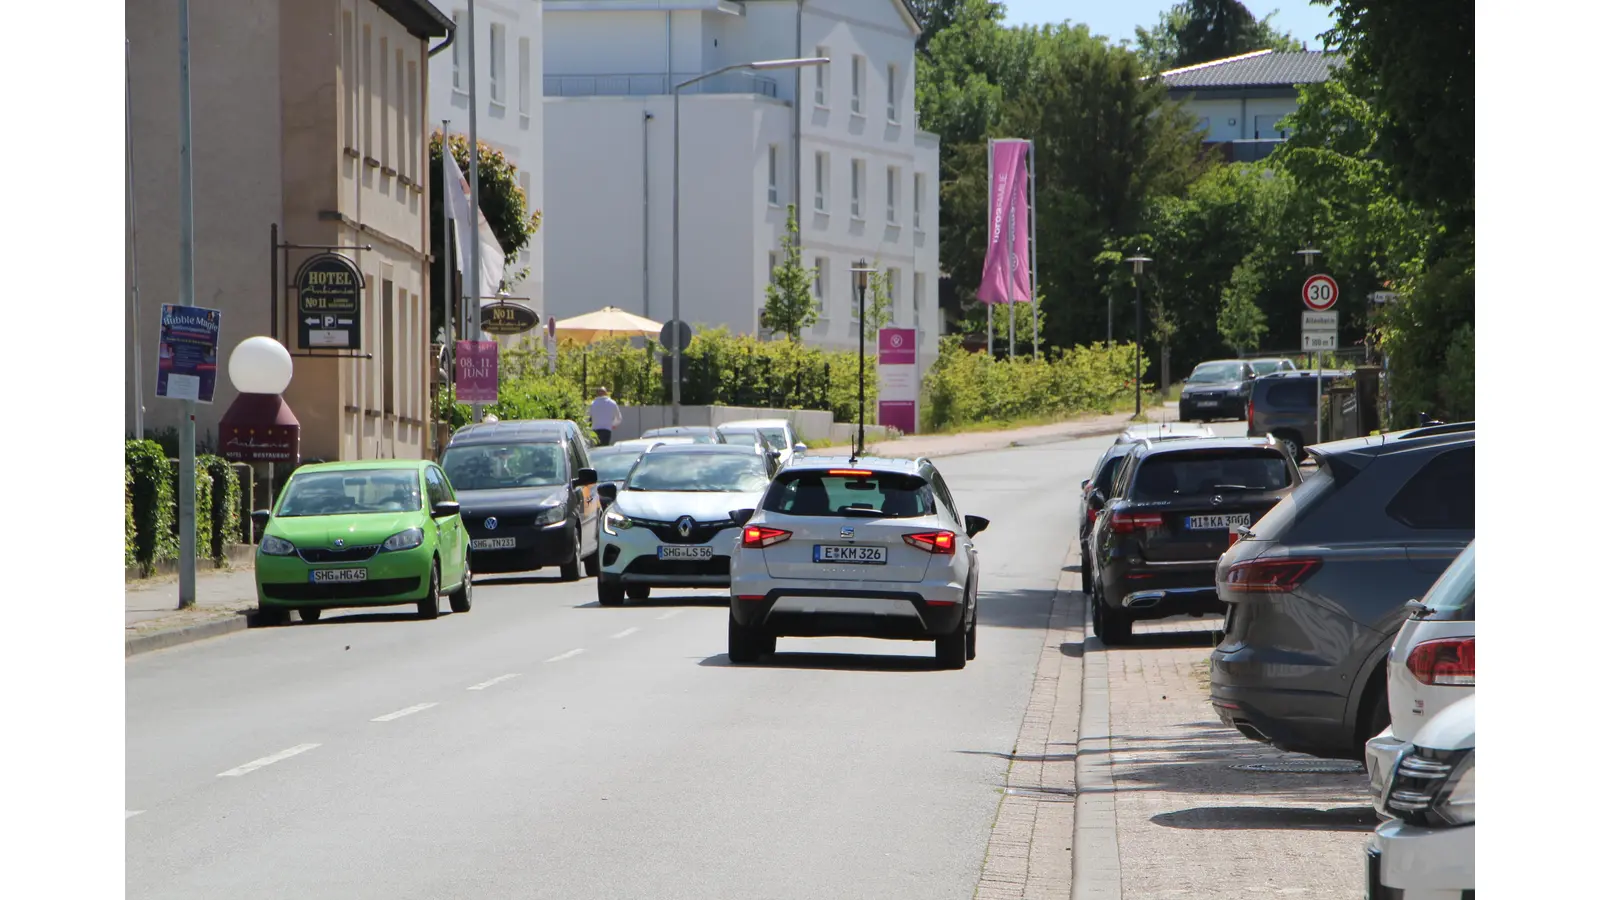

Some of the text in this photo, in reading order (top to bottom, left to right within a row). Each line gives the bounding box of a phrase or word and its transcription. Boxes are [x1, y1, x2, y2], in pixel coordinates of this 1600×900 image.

[309, 271, 352, 285] HOTEL
[1310, 285, 1330, 300] 30
[506, 308, 515, 320] 11
[163, 315, 195, 326] Bubble
[196, 317, 218, 332] Magic
[324, 316, 334, 327] P
[463, 368, 489, 379] JUNI
[1210, 516, 1223, 528] KA
[663, 548, 711, 557] SHG LS 56
[825, 547, 881, 560] E KM 326
[340, 570, 353, 579] HG
[353, 569, 366, 579] 45
